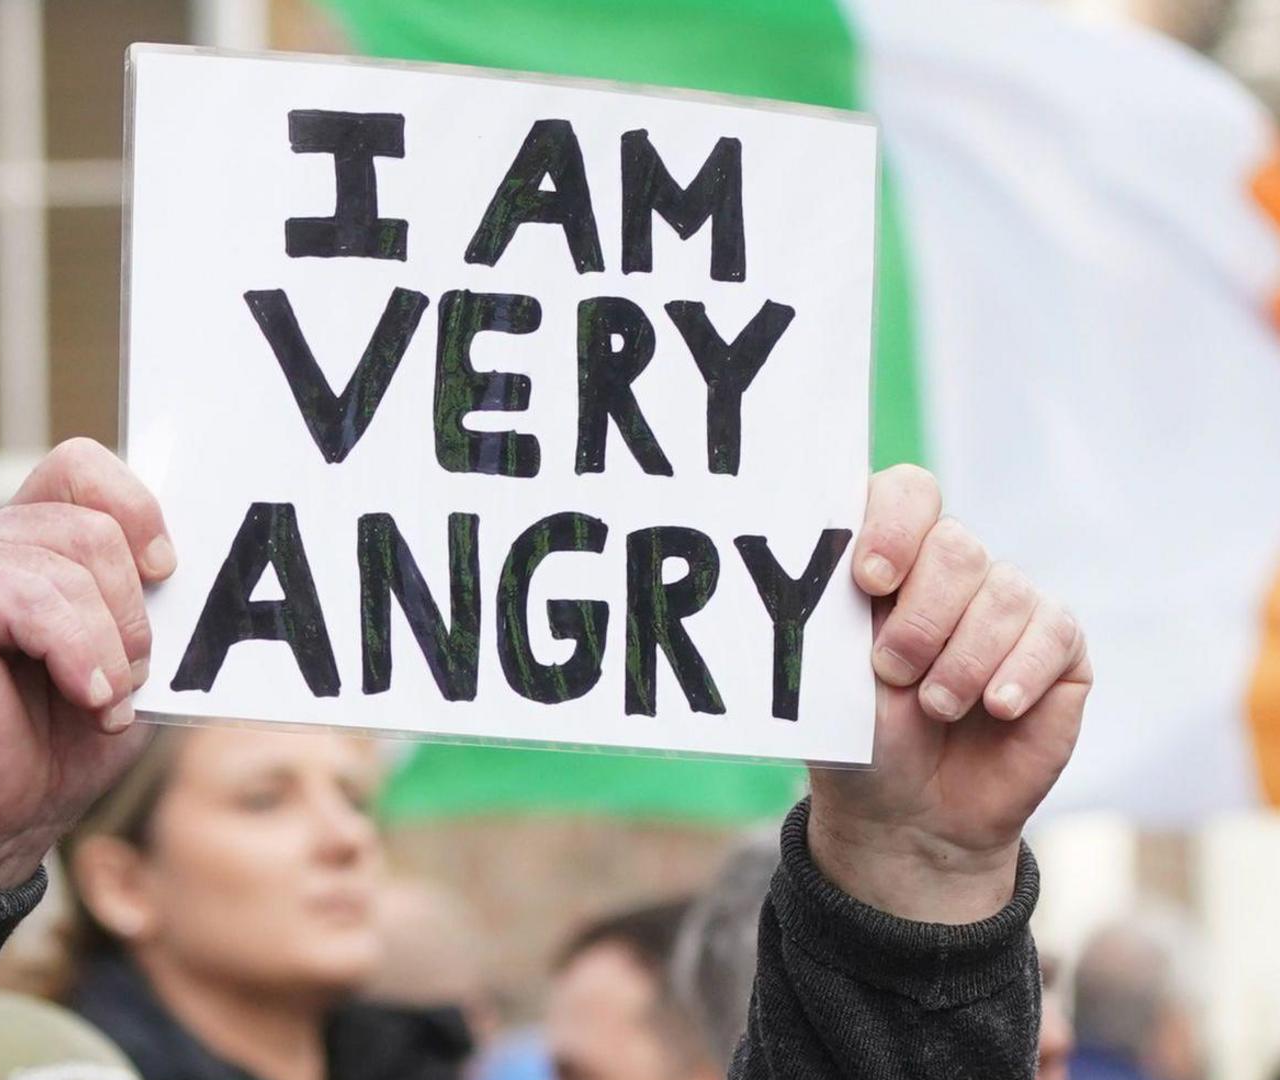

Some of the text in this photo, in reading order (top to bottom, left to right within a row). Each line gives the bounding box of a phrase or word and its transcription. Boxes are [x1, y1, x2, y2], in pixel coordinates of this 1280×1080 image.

[285, 109, 746, 282] I AM
[243, 286, 796, 477] VERY
[169, 501, 853, 721] ANGRY
